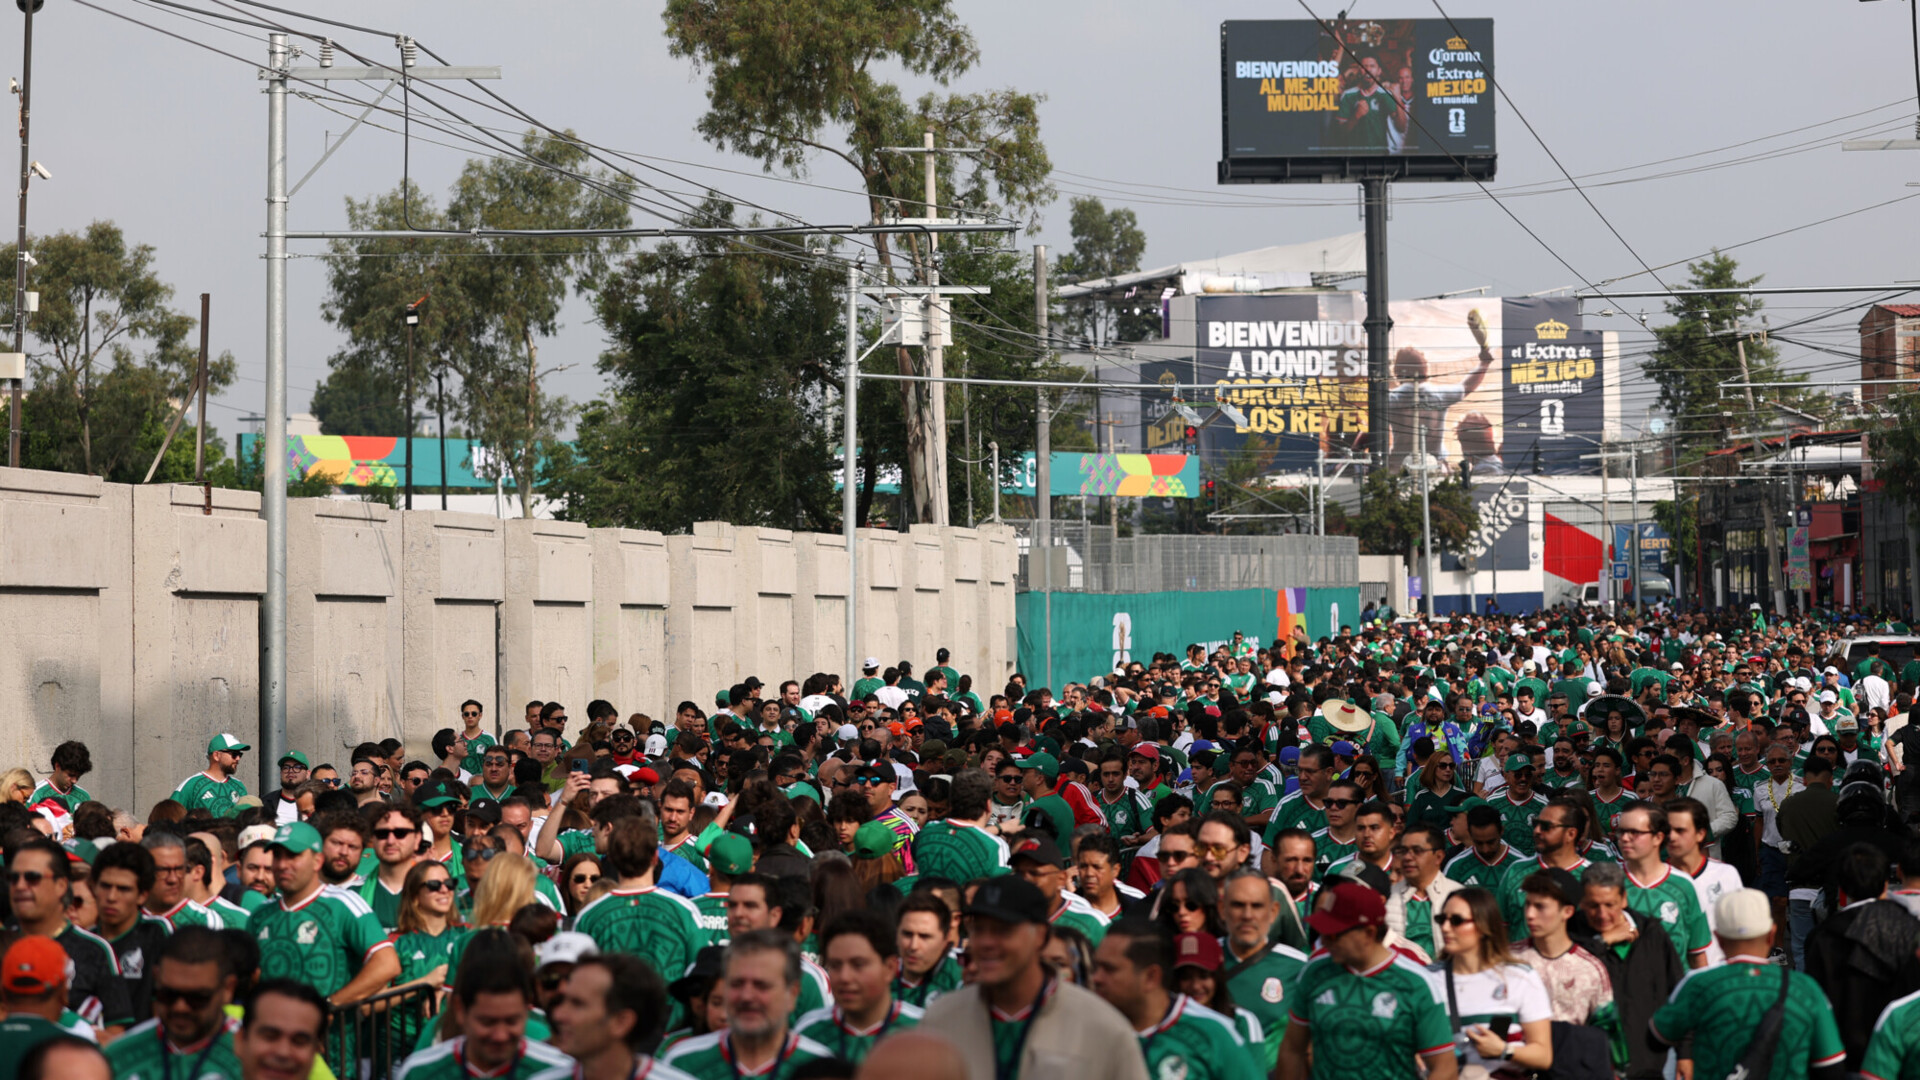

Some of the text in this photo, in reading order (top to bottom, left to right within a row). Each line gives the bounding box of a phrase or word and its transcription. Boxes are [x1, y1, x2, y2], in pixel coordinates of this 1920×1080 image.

[1428, 48, 1483, 67] Corona
[1235, 60, 1340, 79] BIENVENIDOS
[1426, 67, 1485, 80] el Extra de
[1259, 77, 1340, 95] AL MEJOR
[1426, 78, 1487, 98] MÉXICO
[1267, 94, 1340, 112] MUNDIAL
[1443, 94, 1478, 104] mundial
[1208, 319, 1368, 347] BIENVENIDO
[1511, 342, 1592, 359] el Extra de
[1227, 350, 1247, 377] A
[1251, 350, 1339, 377] DONDE
[1511, 358, 1596, 384] MÉXICO
[1215, 378, 1340, 406] CORONAN
[1519, 381, 1583, 394] es mundial
